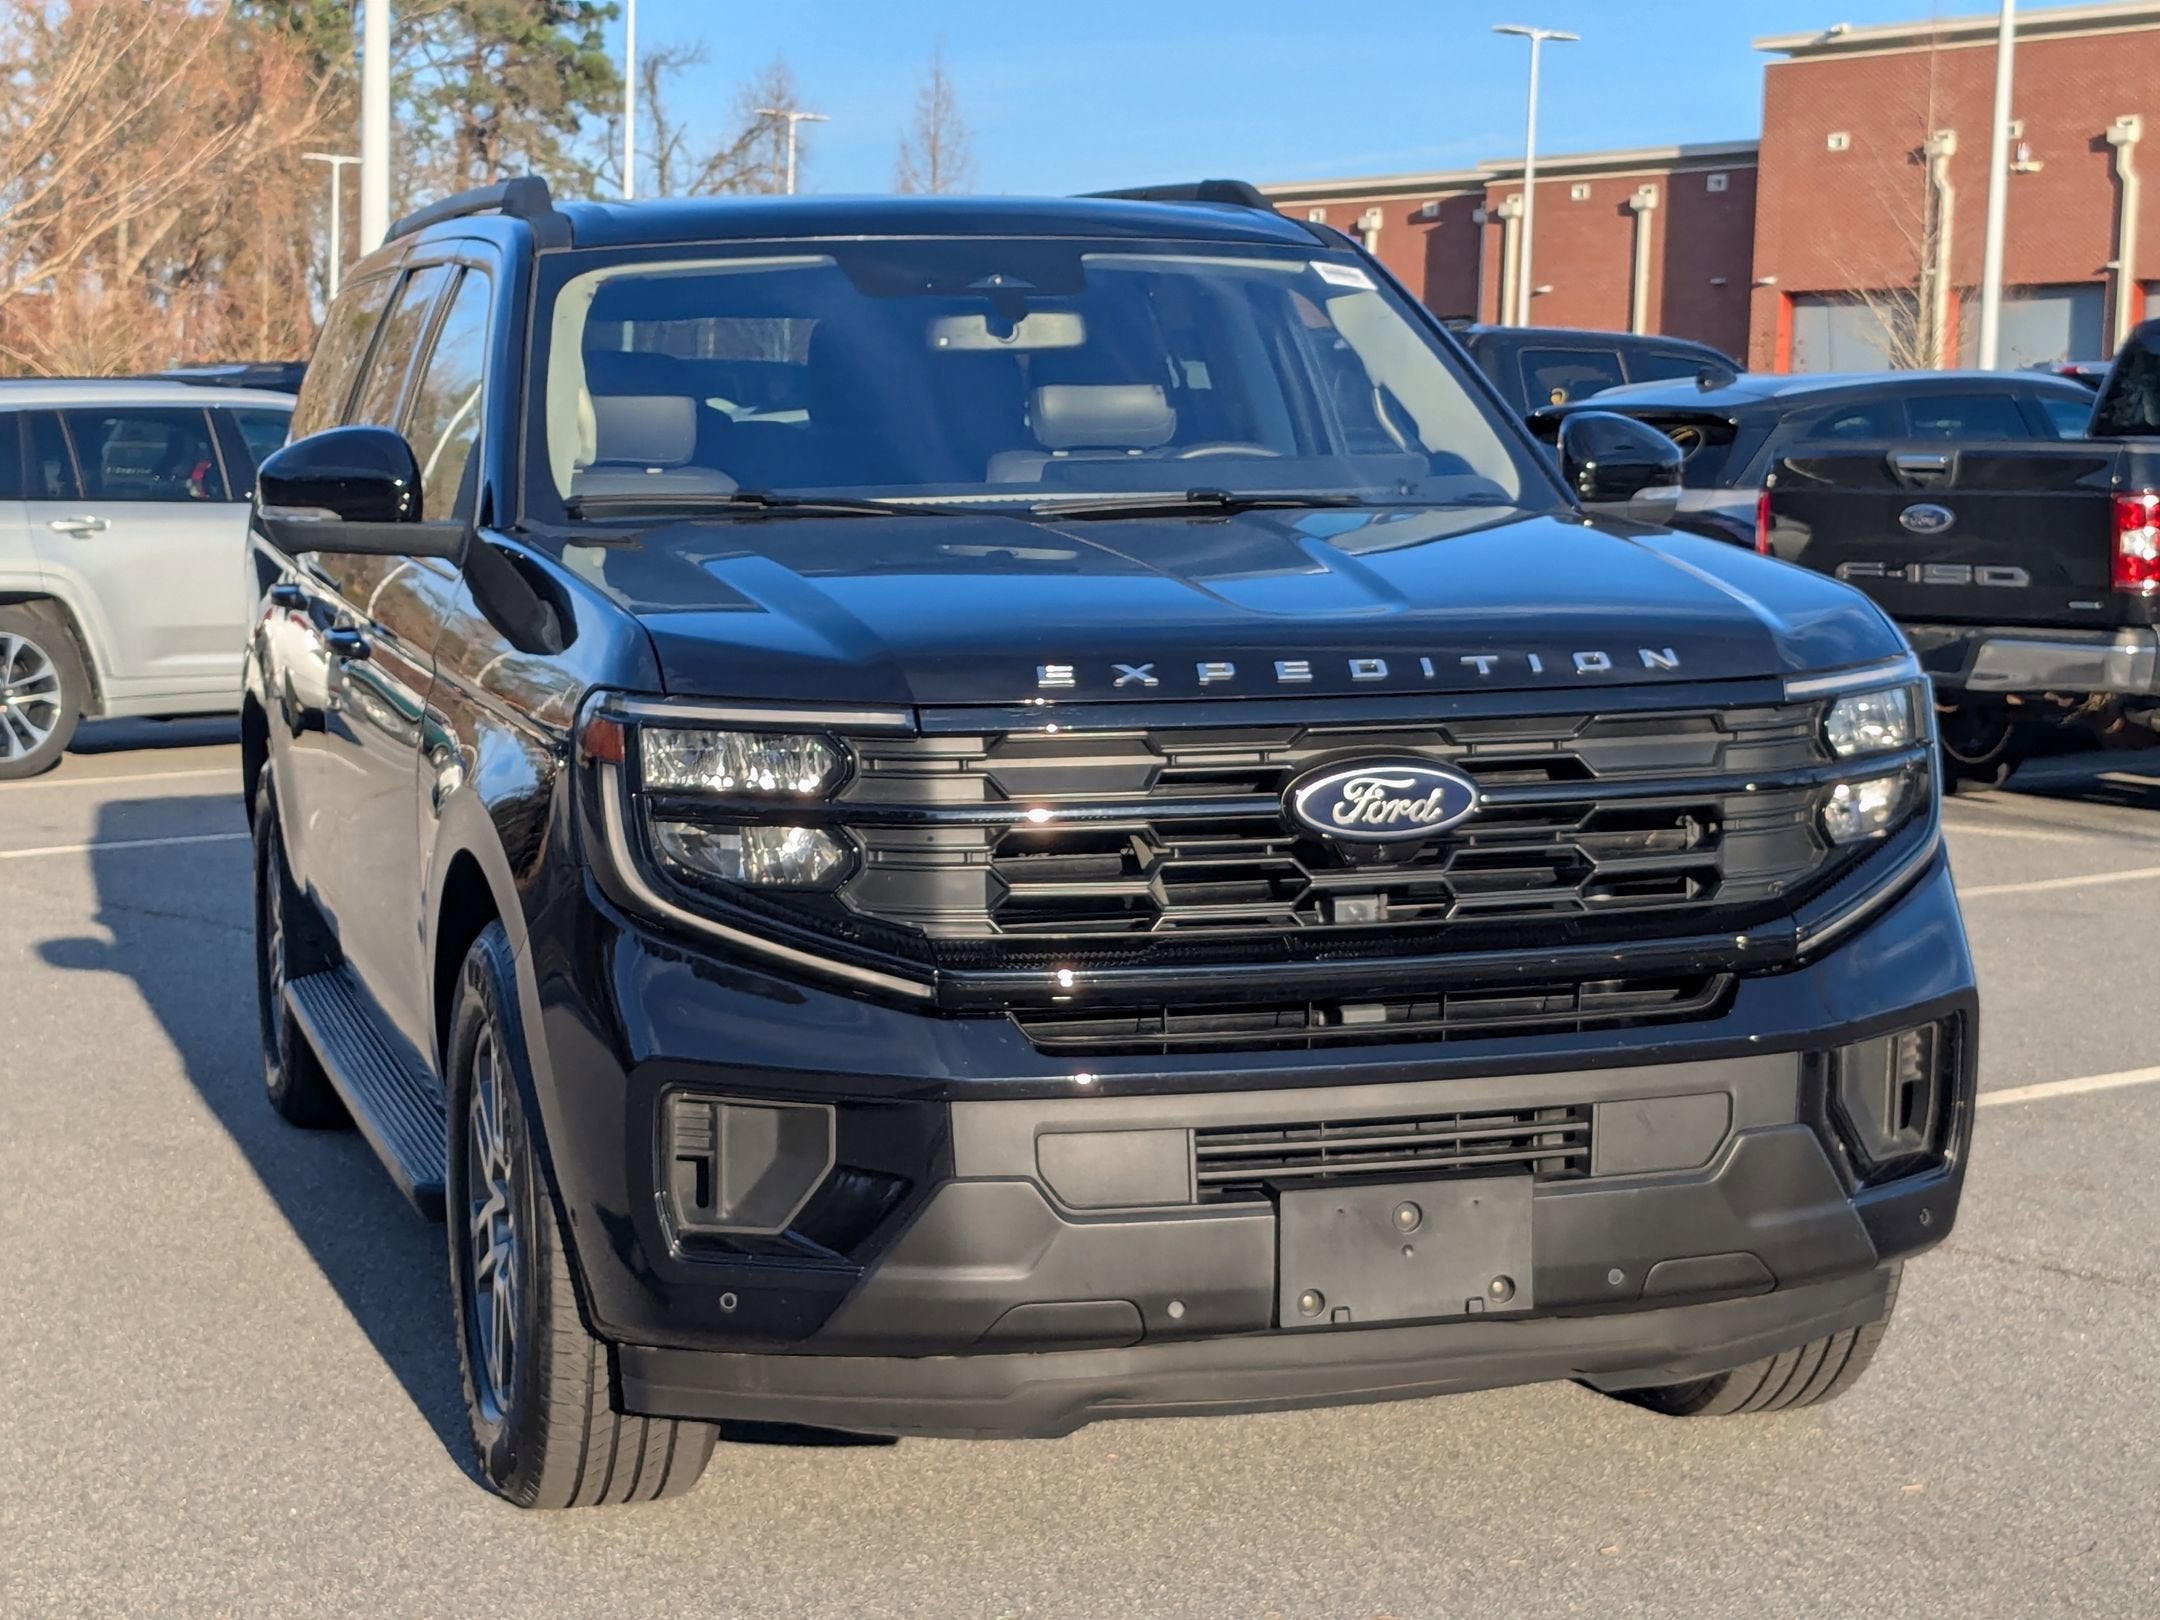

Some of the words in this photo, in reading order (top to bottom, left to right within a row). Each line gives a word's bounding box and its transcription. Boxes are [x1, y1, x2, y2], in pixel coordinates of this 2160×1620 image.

[1835, 561, 2029, 587] F-150
[1036, 646, 1681, 687] EXPEDITION
[1332, 777, 1443, 825] Ford
